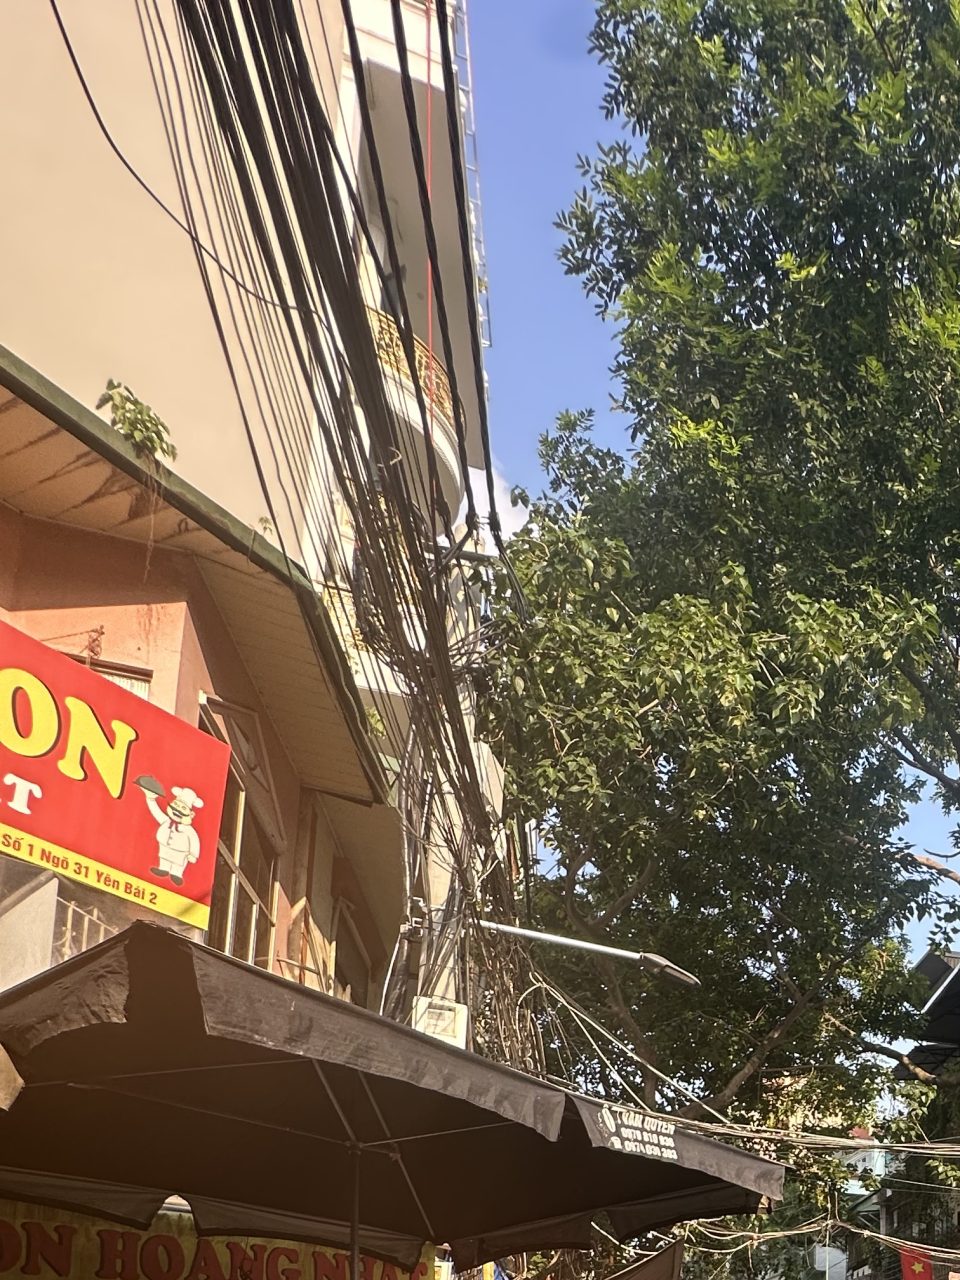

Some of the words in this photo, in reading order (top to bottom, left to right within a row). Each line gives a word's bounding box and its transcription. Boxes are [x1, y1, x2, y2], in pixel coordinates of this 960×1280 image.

[0, 772, 43, 815] T
[1, 833, 24, 851] Số
[27, 843, 35, 857] 1
[40, 847, 69, 871] Ngõ
[73, 861, 90, 878] 31
[95, 869, 120, 890] Yên
[124, 880, 146, 901] Bái
[149, 892, 158, 905] 2
